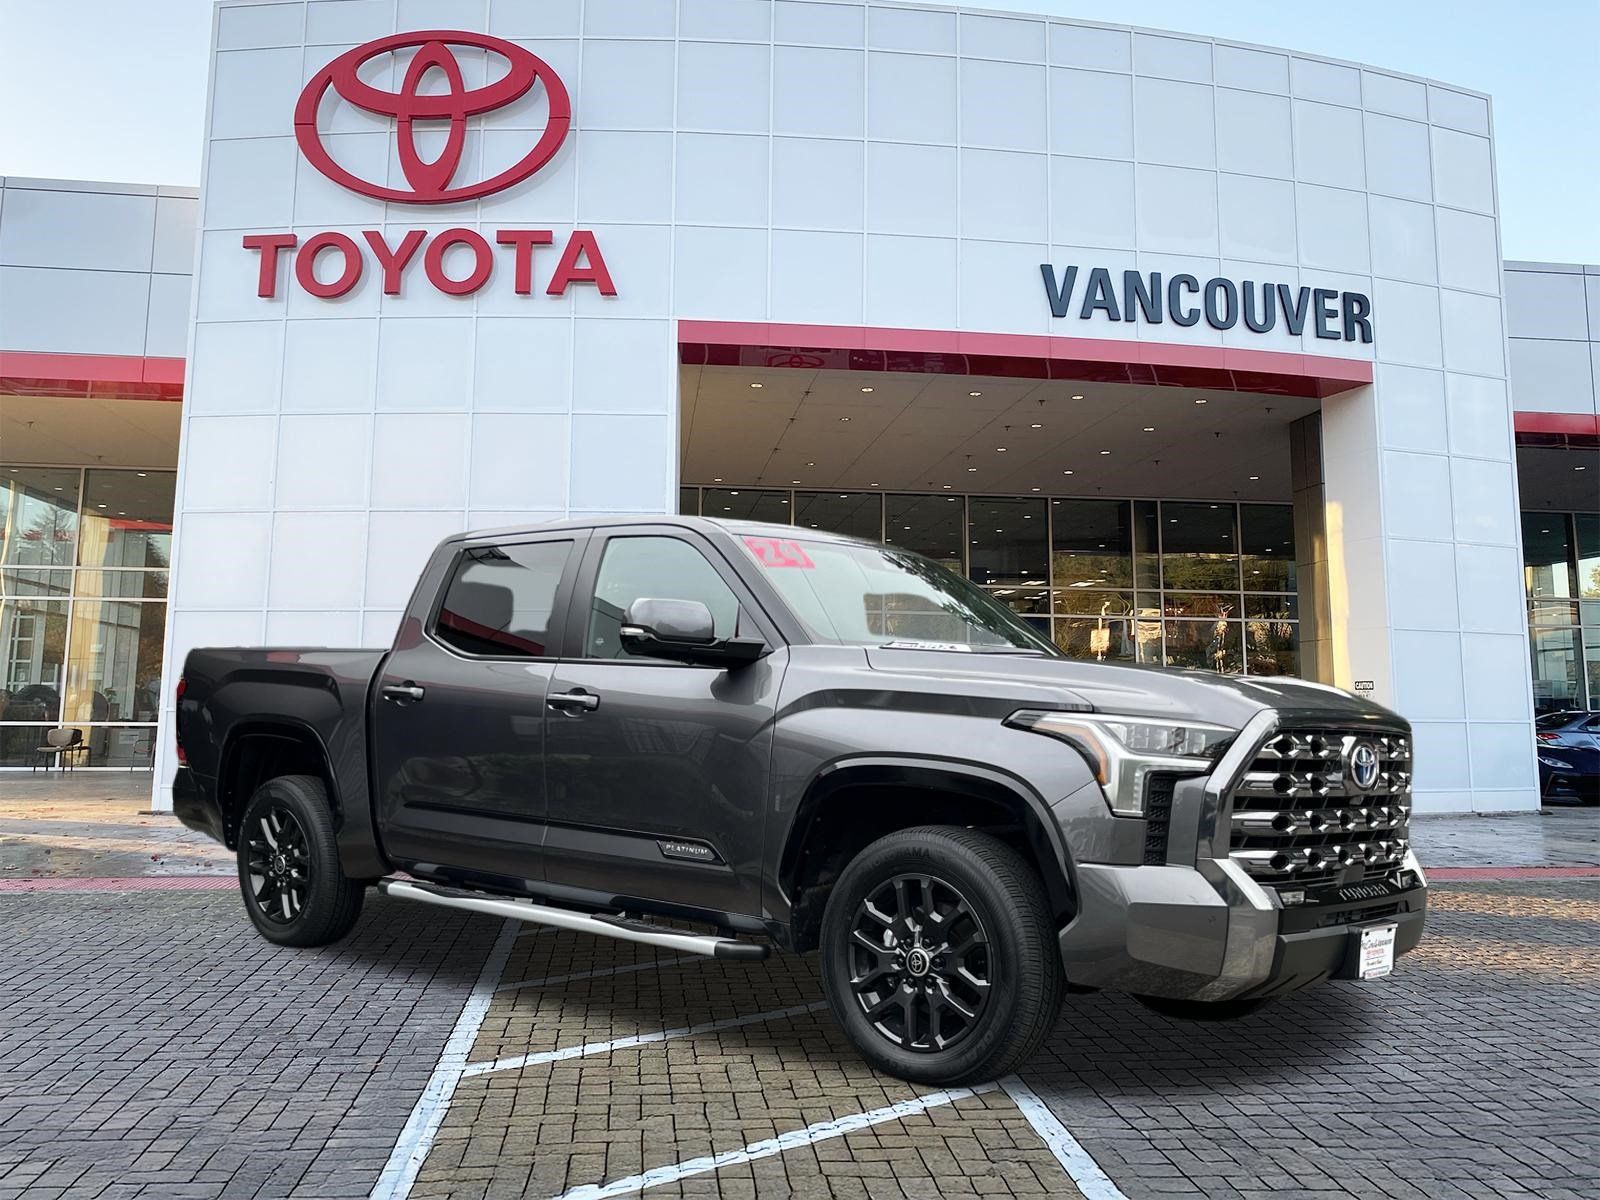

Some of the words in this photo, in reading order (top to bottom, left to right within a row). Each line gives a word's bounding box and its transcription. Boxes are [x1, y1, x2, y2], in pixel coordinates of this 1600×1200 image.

[244, 228, 617, 299] TOYOTA
[1040, 264, 1374, 344] VANCOUVER
[665, 844, 708, 855] PLATINUM
